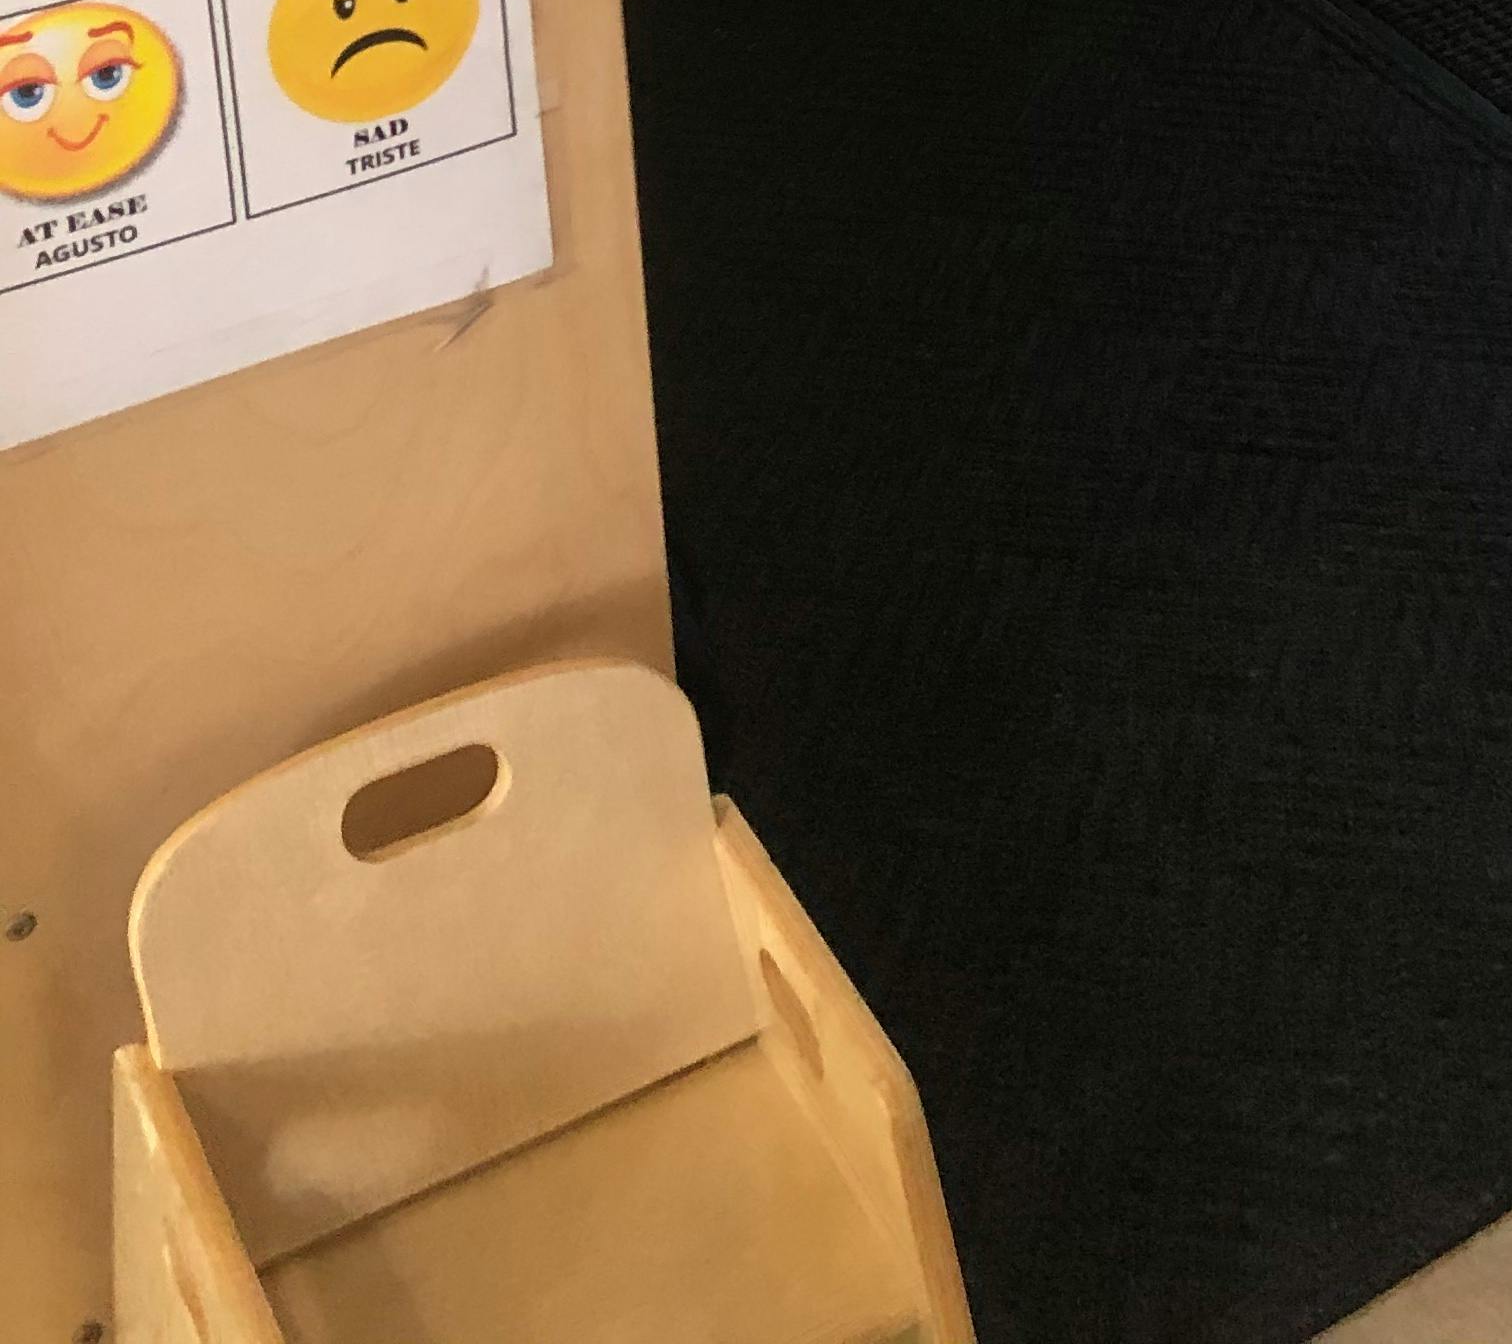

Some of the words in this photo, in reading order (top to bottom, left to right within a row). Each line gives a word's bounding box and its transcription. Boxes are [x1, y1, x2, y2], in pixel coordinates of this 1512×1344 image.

[352, 117, 410, 150] SAD
[345, 138, 422, 177] TRISTE
[16, 217, 61, 250] AT
[69, 192, 149, 231] EASE
[34, 222, 139, 270] AGUSTO
